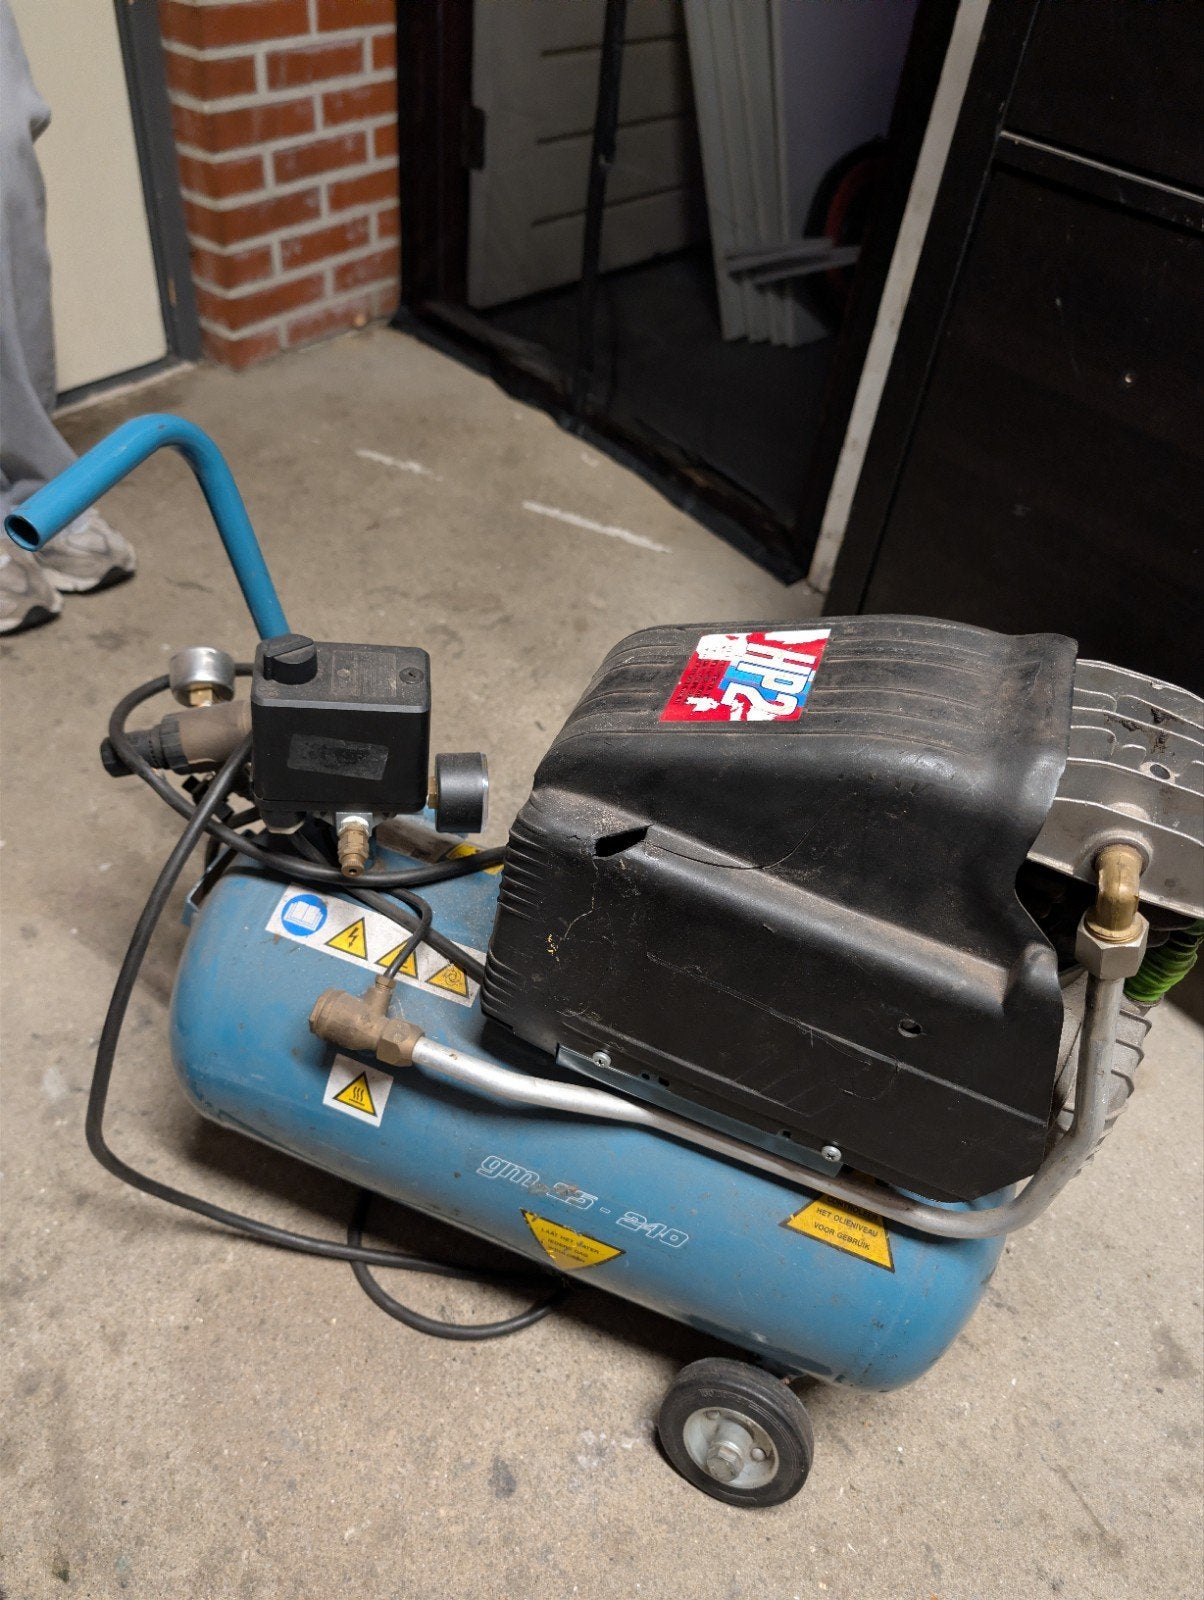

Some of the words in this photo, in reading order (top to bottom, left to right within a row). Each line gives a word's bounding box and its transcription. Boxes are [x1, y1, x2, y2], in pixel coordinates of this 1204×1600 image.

[719, 642, 817, 716] HP2
[615, 1211, 689, 1248] 240
[814, 1221, 835, 1236] VOOR
[837, 1231, 871, 1251] GEBRUIK
[816, 1207, 832, 1218] HET
[833, 1214, 879, 1237] OLIENIVEAU
[577, 1240, 600, 1255] ATER
